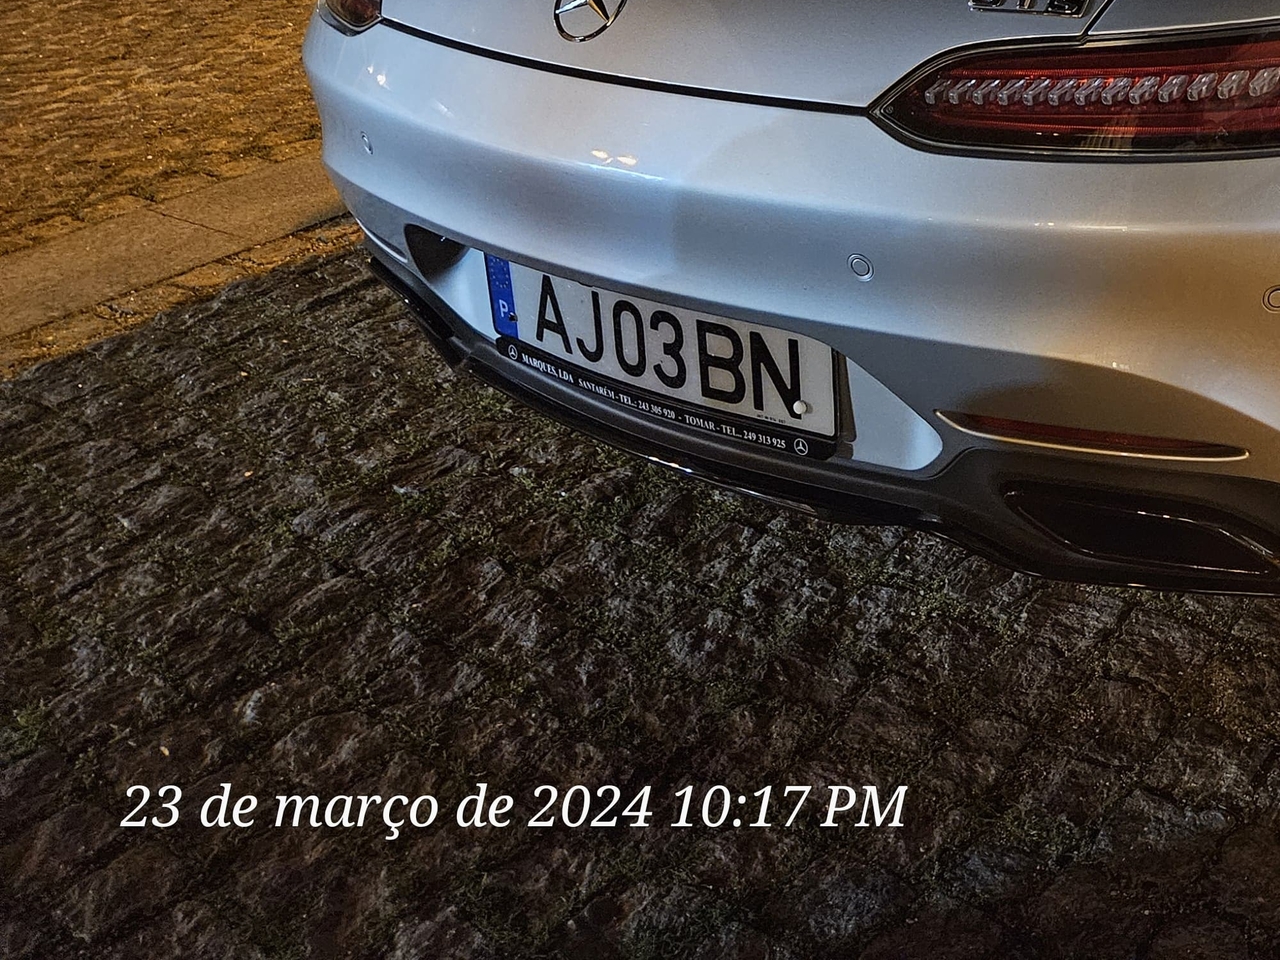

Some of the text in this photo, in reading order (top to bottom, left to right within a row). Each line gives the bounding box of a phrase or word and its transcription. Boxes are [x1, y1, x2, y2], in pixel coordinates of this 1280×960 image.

[498, 299, 510, 318] P
[558, 368, 574, 384] LDA
[578, 378, 615, 400] SANTARÉM
[638, 400, 650, 412] 243
[650, 403, 662, 415] 305
[663, 407, 676, 420] 920
[684, 414, 716, 431] TOMAR
[743, 430, 757, 441] 249
[757, 433, 772, 445] 313
[772, 437, 787, 449] 925
